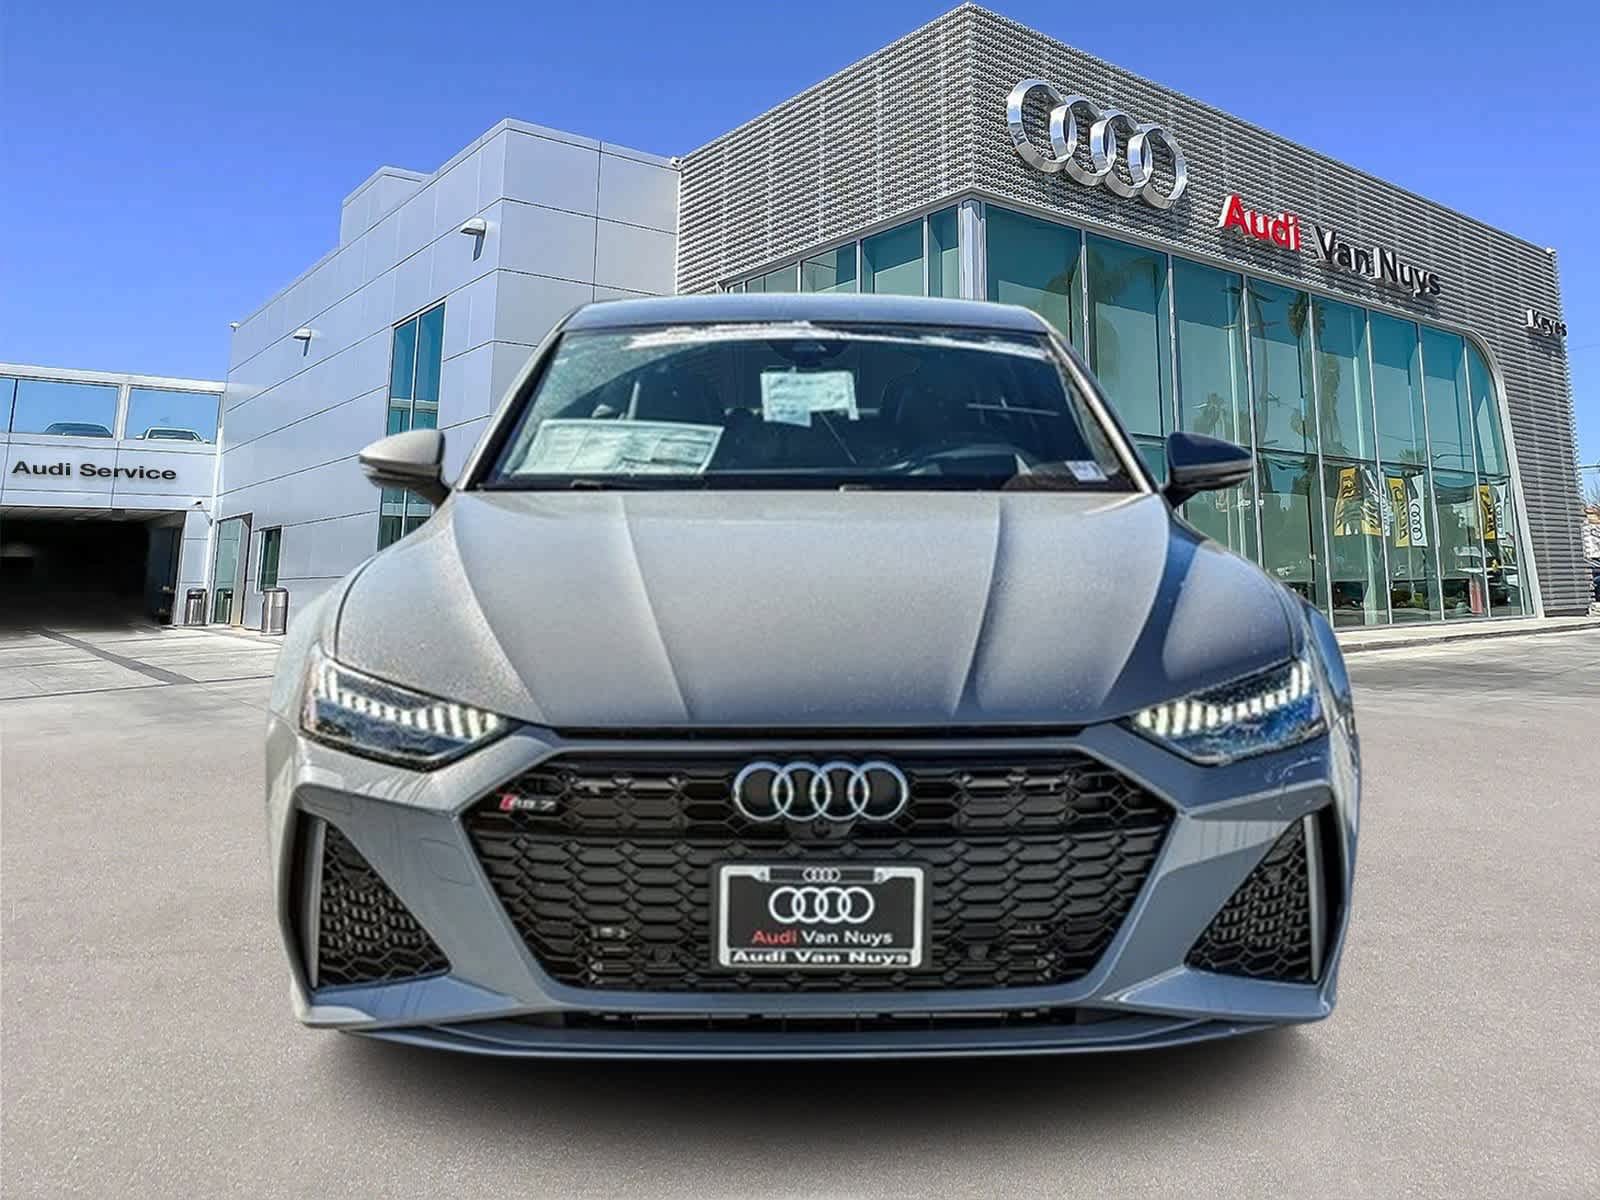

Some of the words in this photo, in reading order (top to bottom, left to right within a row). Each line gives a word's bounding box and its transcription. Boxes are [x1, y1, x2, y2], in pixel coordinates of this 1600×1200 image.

[1218, 194, 1301, 251] Audi
[1312, 225, 1372, 274] Van
[1373, 248, 1441, 297] Nuys
[1527, 309, 1567, 336] Keyes
[12, 460, 71, 476] Audi
[80, 463, 177, 480] Service
[752, 930, 797, 944] Audi
[802, 930, 838, 943] Van
[844, 931, 893, 946] Nuys
[733, 951, 786, 963] Audi
[795, 951, 839, 963] Van
[849, 952, 909, 966] Nuys
